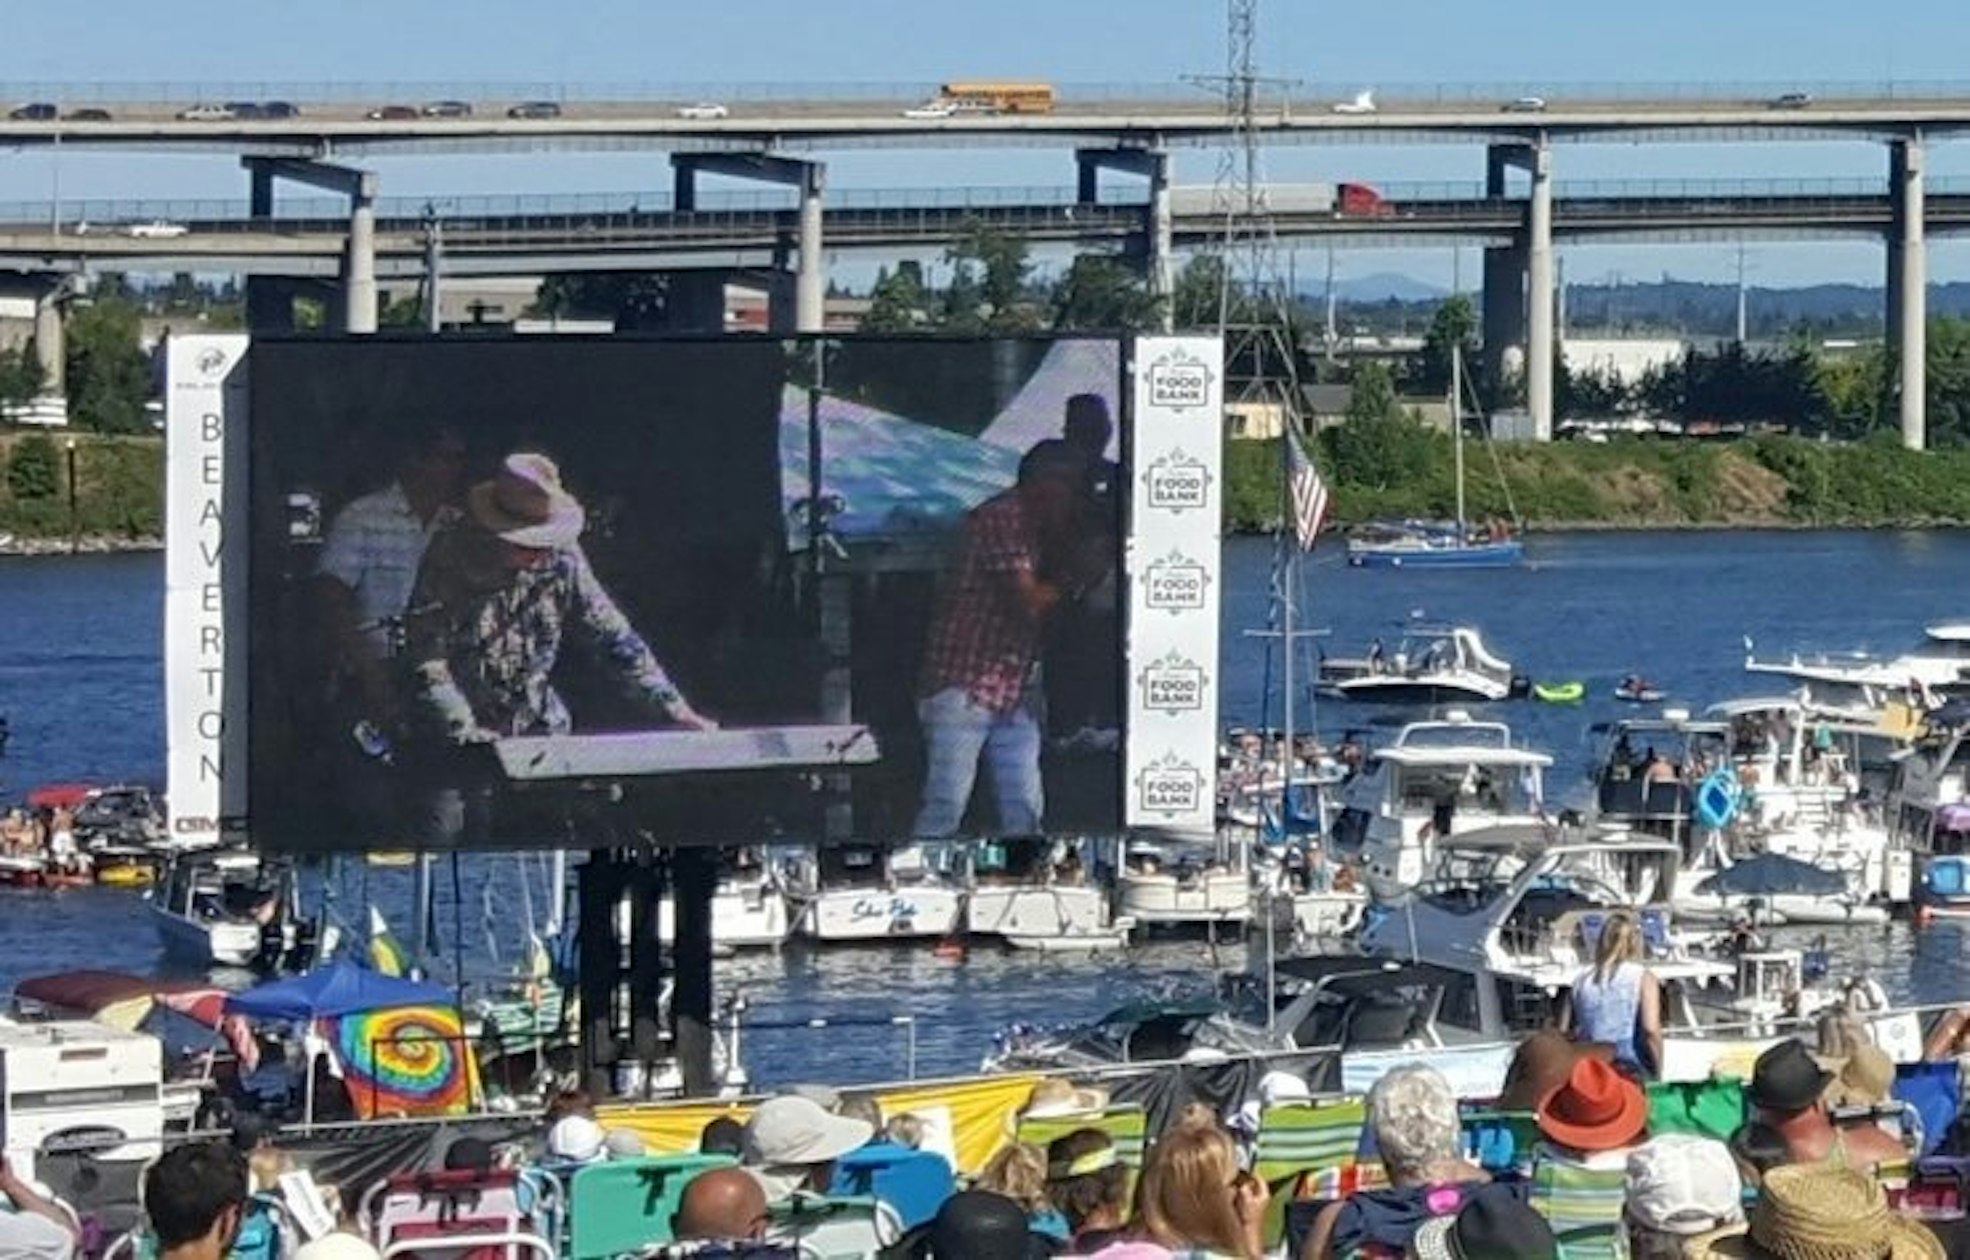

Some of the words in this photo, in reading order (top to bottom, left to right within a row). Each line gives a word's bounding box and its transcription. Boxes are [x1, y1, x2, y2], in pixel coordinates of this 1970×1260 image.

[1156, 376, 1202, 388] FOOD
[1156, 389, 1200, 399] BANK
[1155, 477, 1200, 490] FOOD
[1155, 490, 1199, 501] BANK
[1153, 579, 1199, 591] FOOD
[198, 413, 225, 782] BEAVERTON
[1153, 592, 1197, 602] BANK
[1150, 680, 1197, 691] FOOD
[1150, 693, 1194, 703] BANK
[1147, 781, 1194, 793] FOOD
[1147, 794, 1191, 805] BANK
